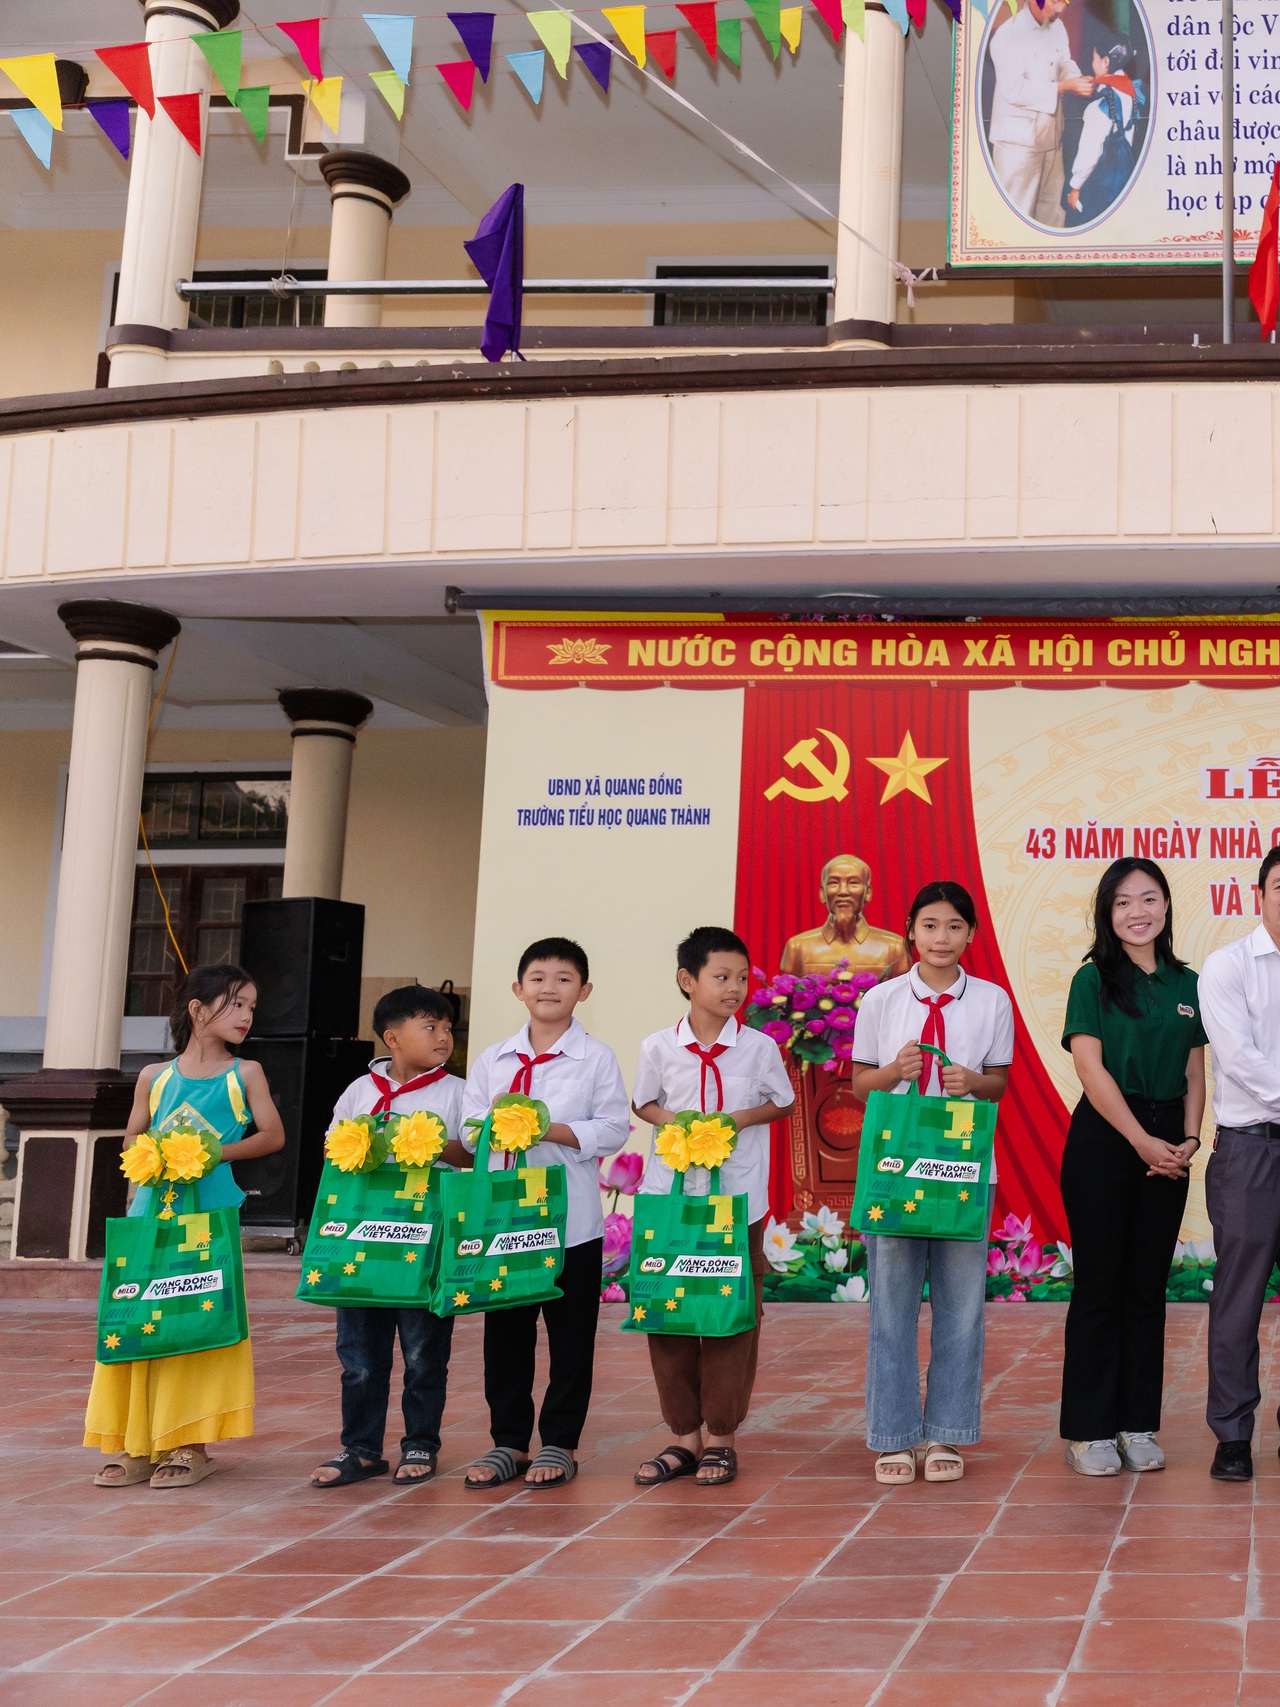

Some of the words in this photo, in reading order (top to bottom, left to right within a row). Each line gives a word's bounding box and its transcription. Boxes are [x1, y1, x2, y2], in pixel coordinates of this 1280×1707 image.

[1166, 15, 1211, 36] dân
[1166, 49, 1197, 71] tới
[1166, 84, 1200, 106] vai
[1207, 84, 1242, 105] vi
[1166, 119, 1220, 141] châu
[1166, 154, 1187, 176] là
[1166, 189, 1207, 217] học
[1214, 191, 1252, 215] tp
[628, 633, 735, 666] NƯỚC
[750, 633, 858, 672] CỘNG
[871, 633, 950, 666] HÒA
[963, 634, 1016, 666] XÃ
[1028, 634, 1093, 672] HỘI
[1107, 630, 1186, 666] CHỦ
[548, 779, 581, 796] UBND
[585, 775, 601, 796] XÃ
[605, 778, 645, 797] QUANG
[649, 772, 682, 795] ĐỒNG
[517, 805, 564, 826] TRƯỜNG
[568, 802, 594, 826] TIỂU
[598, 808, 622, 829] HỌC
[626, 808, 667, 827] QUANG
[671, 803, 711, 825] THÀNH
[1025, 828, 1055, 859] 43
[1065, 822, 1124, 859] NĂM
[1133, 821, 1201, 859] NGÀY
[1210, 821, 1260, 859] NHÀ
[1210, 877, 1245, 916] VÀ
[882, 1161, 901, 1169] MILO
[940, 1170, 962, 1178] NAM
[522, 1239, 544, 1248] NAM
[178, 1283, 203, 1292] NAM
